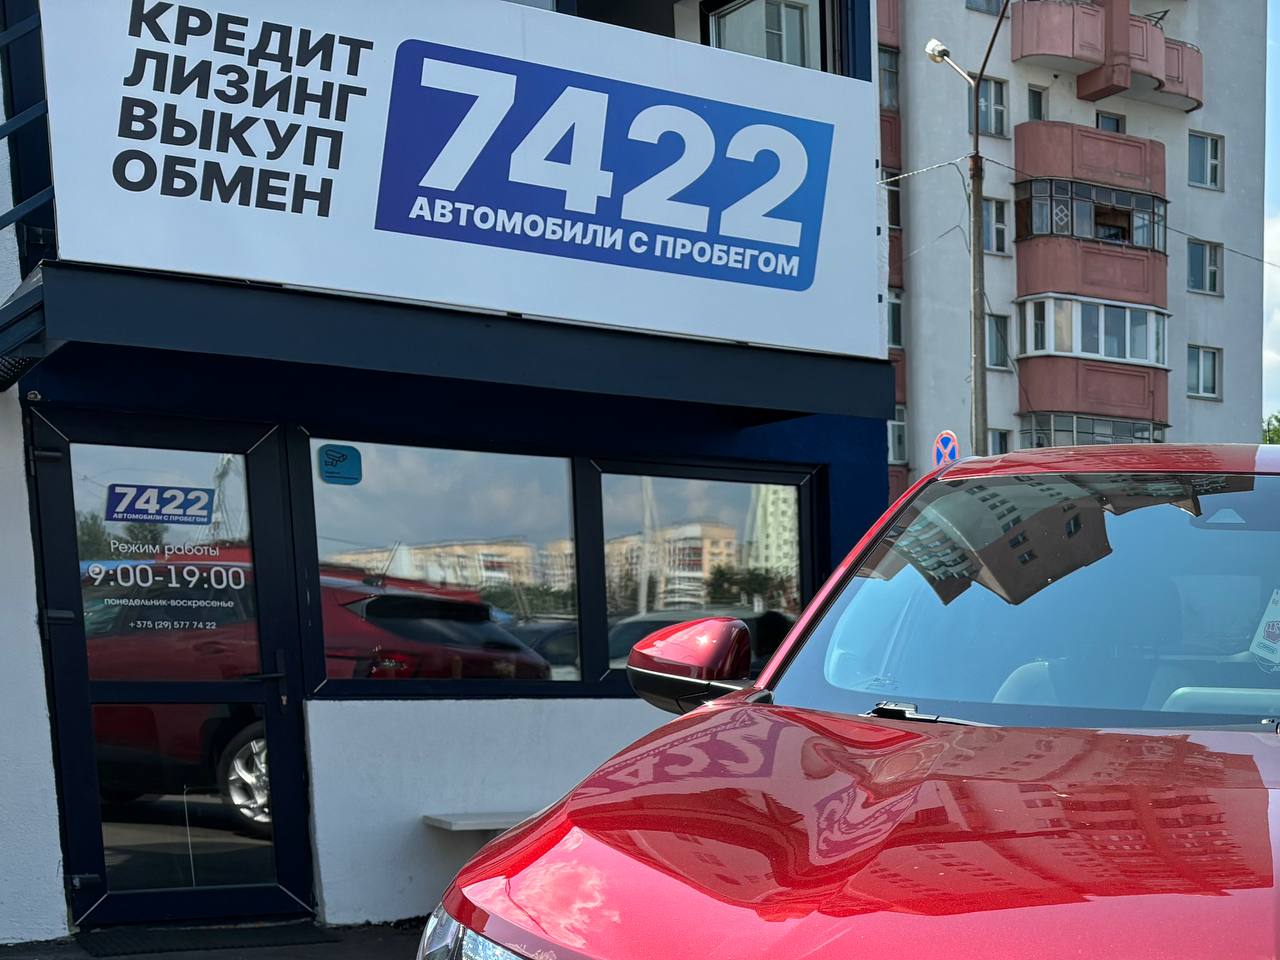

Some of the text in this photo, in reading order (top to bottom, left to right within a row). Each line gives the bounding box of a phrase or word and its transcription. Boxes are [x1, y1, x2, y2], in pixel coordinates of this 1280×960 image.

[128, 0, 374, 76] КРЕДИТ
[123, 48, 367, 122] ЛИЗИНГ
[118, 96, 343, 170] ВЫКУП
[418, 57, 809, 248] 7422
[112, 149, 333, 217] ОБМЕН
[408, 196, 801, 277] АВТОМОБИЛИ С ПРОБЕГОМ
[114, 486, 209, 516] 7422
[88, 563, 245, 590] 9:00-19:00
[110, 540, 220, 558] Режим работы
[104, 598, 234, 608] понедельник-воскресенье
